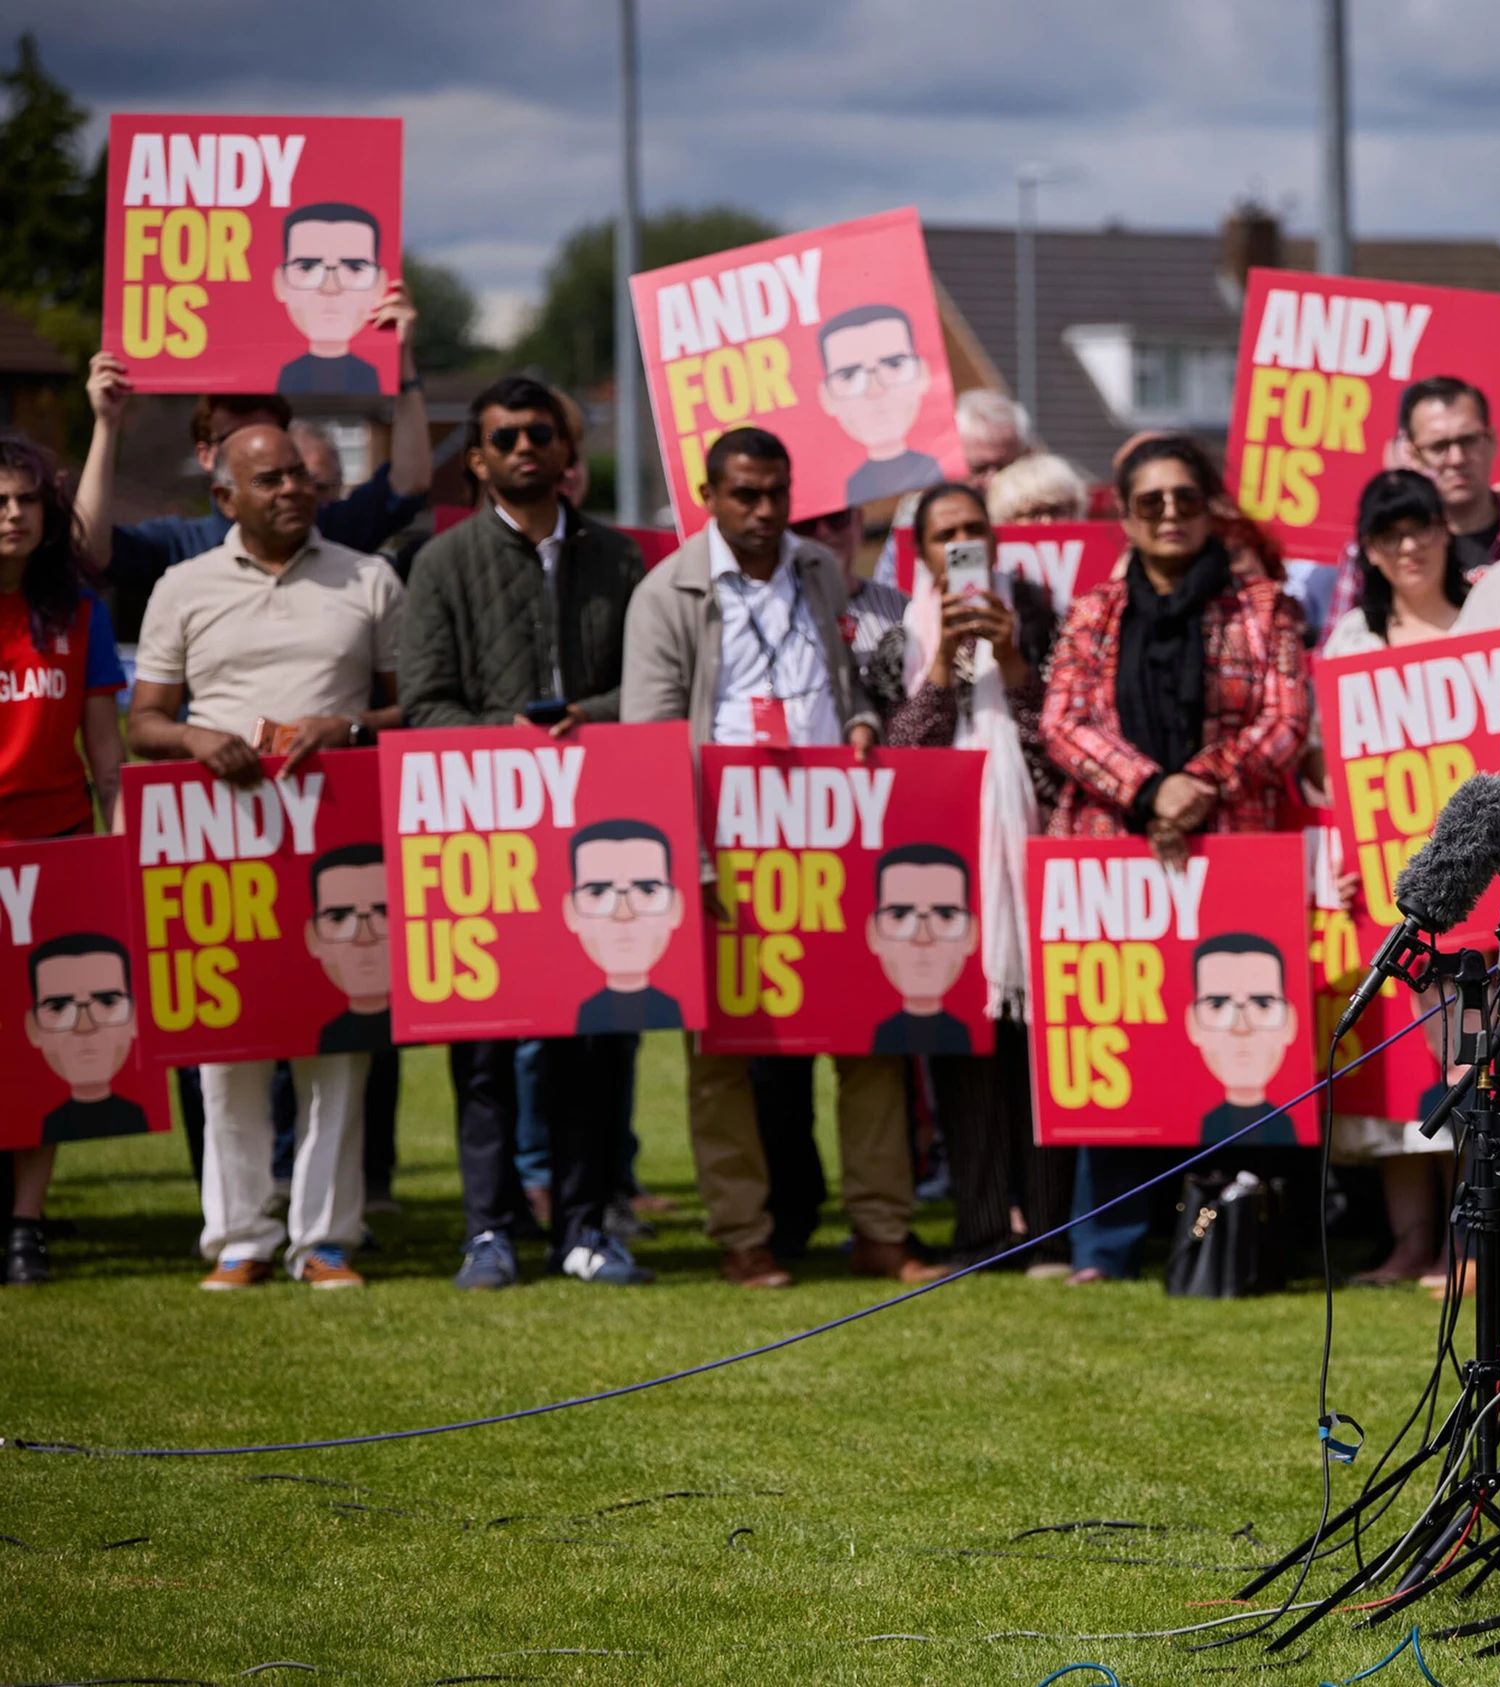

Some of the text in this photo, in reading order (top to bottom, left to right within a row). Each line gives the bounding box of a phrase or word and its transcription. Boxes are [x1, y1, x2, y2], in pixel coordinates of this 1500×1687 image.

[123, 133, 306, 207] ANDY
[123, 208, 251, 282] FOR
[122, 284, 209, 359] US
[656, 248, 822, 362] ANDY
[1253, 289, 1432, 381] ANDY
[665, 337, 798, 434] FOR
[1245, 366, 1371, 455] FOR
[1238, 443, 1324, 527] US
[0, 667, 66, 703] GLAND
[139, 772, 325, 866] ANDY
[398, 746, 586, 834] ANDY
[715, 765, 896, 850] ANDY
[142, 860, 281, 949] FOR
[401, 832, 541, 917] FOR
[717, 849, 846, 932] FOR
[1040, 856, 1209, 941] ANDY
[148, 946, 242, 1032] US
[405, 917, 500, 1003] US
[717, 933, 805, 1018] US
[1042, 941, 1168, 1024] FOR
[1046, 1025, 1132, 1109] US
